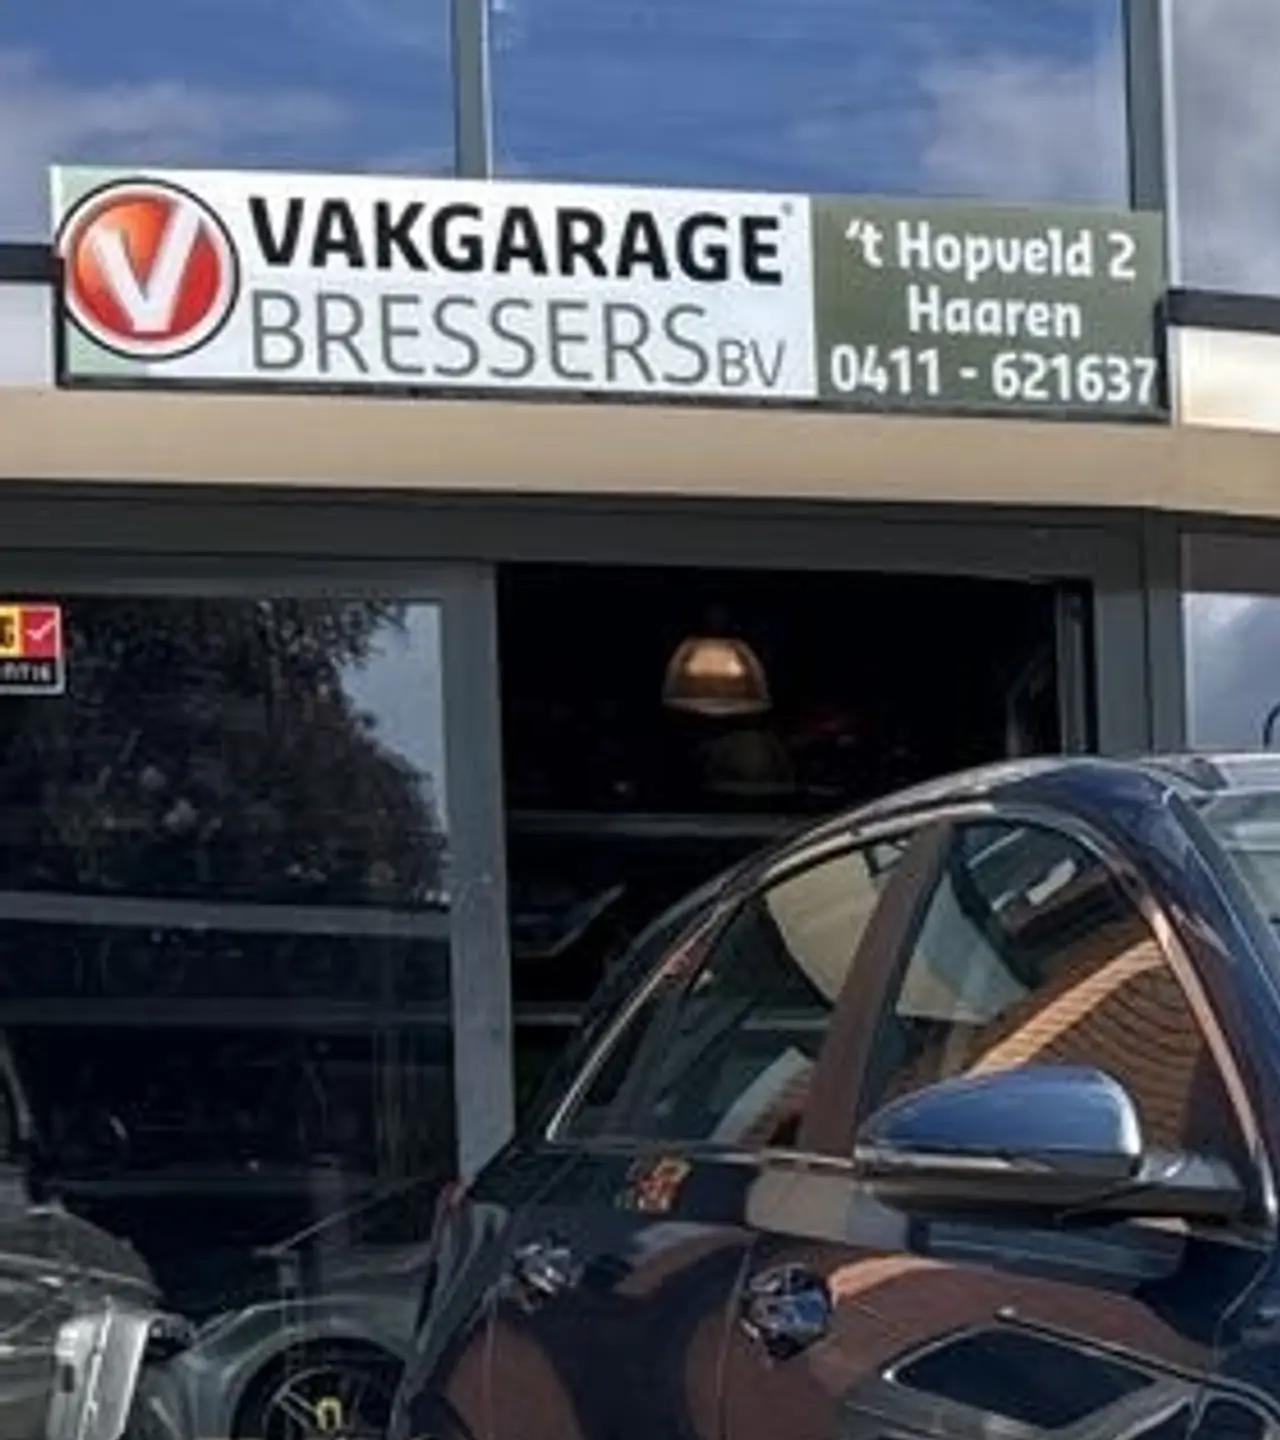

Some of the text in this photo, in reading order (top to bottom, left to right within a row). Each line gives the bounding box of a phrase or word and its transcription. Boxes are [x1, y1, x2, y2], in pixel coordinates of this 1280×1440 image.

[249, 195, 784, 287] VAKGARAGE
[899, 222, 1093, 281] Hopveld
[1107, 232, 1137, 282] 2
[251, 289, 787, 388] BRESSERS BV
[907, 285, 1082, 339] Haaren
[829, 345, 940, 396] 0411
[990, 353, 1158, 402] 621637
